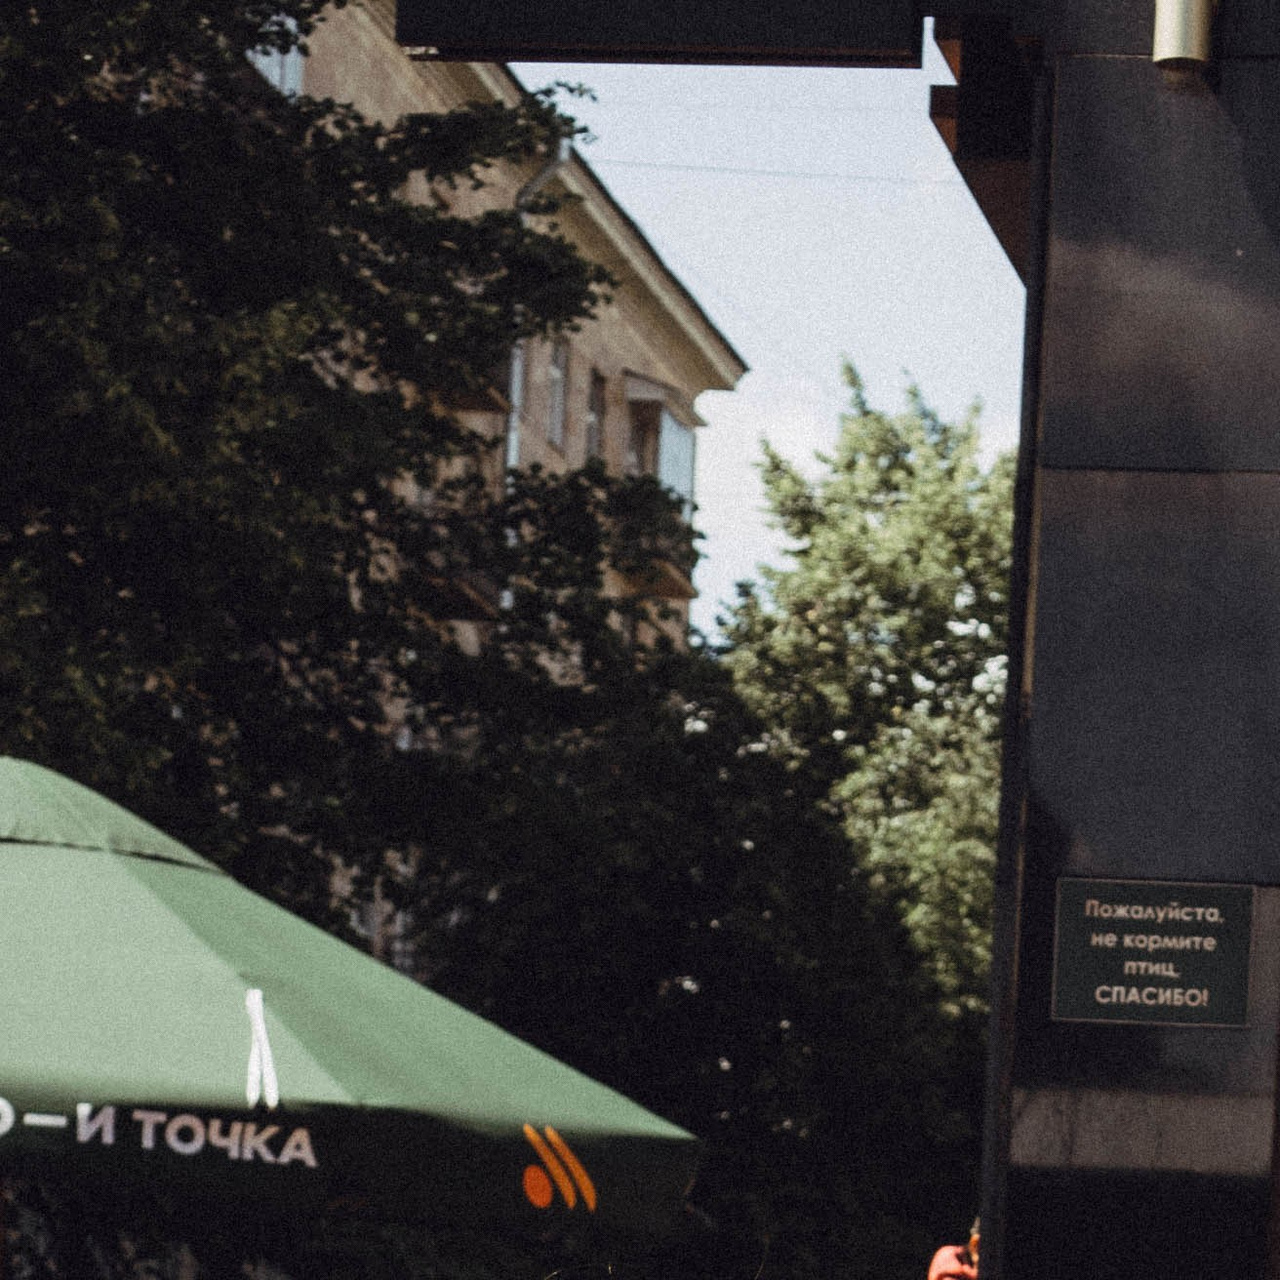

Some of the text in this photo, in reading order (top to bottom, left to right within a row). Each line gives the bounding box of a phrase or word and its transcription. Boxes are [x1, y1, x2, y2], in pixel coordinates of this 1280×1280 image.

[1090, 932, 1217, 951] не кормите
[1095, 985, 1210, 1006] СПАСИБО!
[76, 1102, 116, 1145] И
[132, 1109, 318, 1168] ТОЧКА
